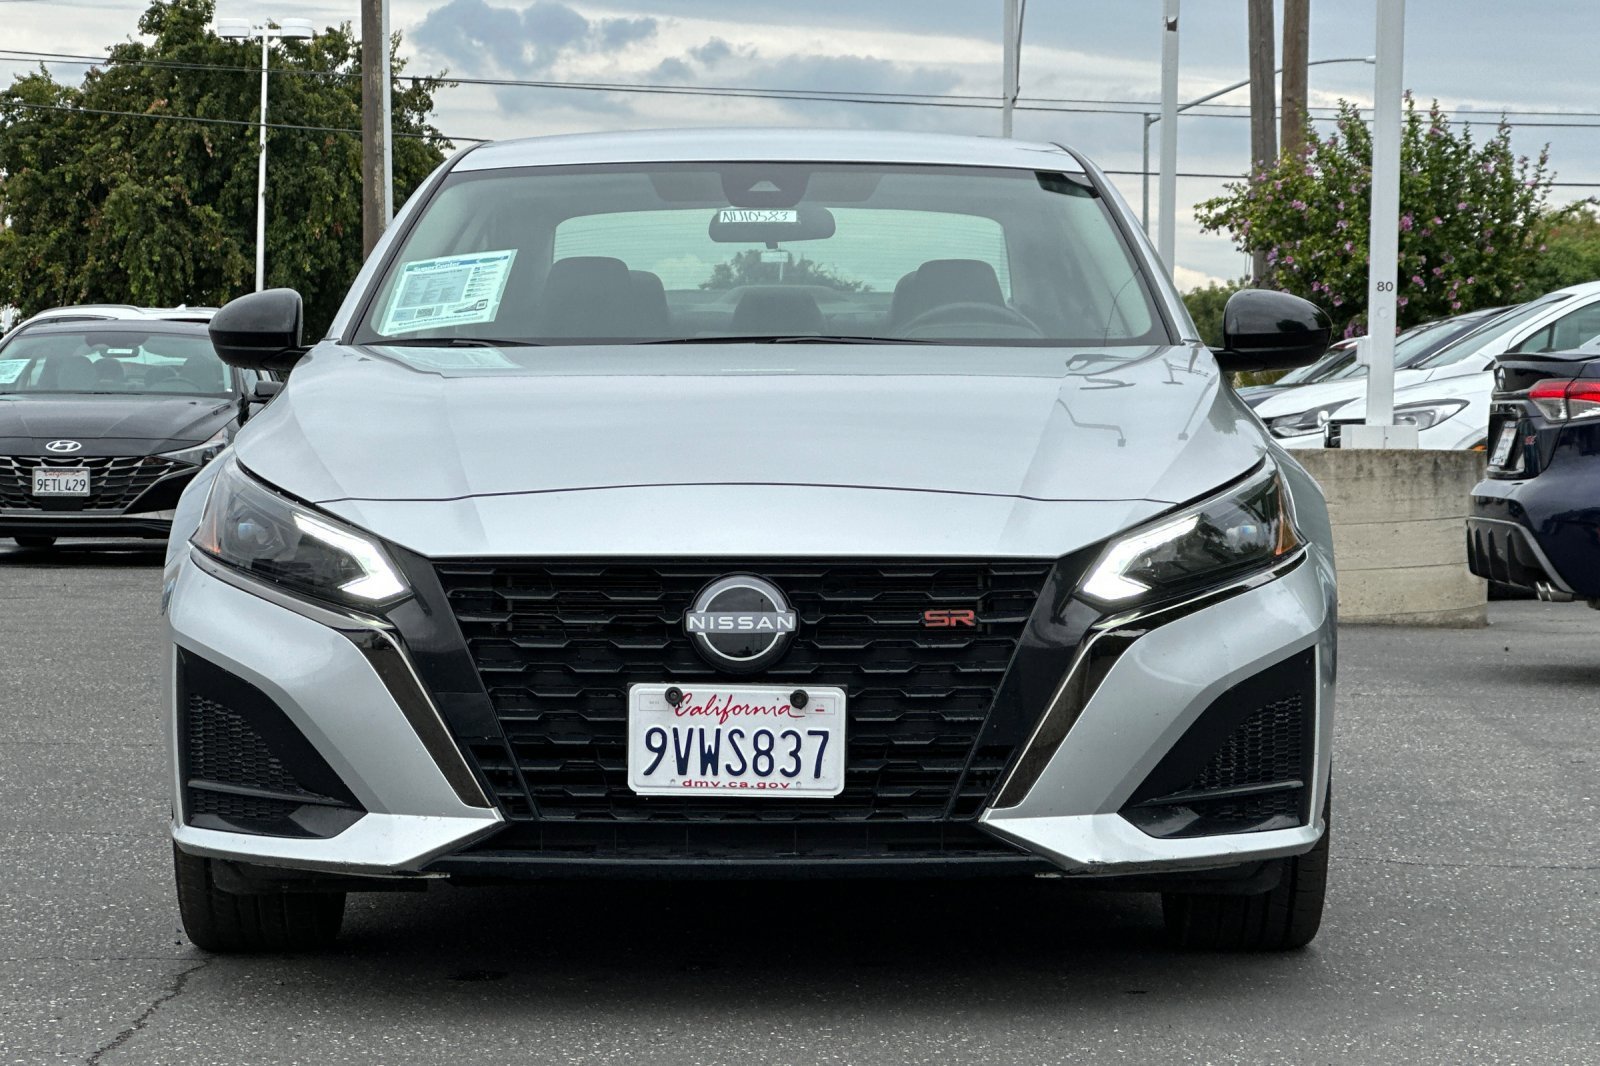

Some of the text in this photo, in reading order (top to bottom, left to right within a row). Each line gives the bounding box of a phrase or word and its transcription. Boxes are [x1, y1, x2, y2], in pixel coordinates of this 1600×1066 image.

[1376, 281, 1394, 292] 80
[37, 478, 87, 492] 9ETL429
[689, 615, 793, 630] NISSAN
[924, 609, 975, 627] SR
[675, 693, 805, 724] California
[643, 727, 829, 779] 9VWS837
[682, 779, 790, 789] dmv.ca.gov
